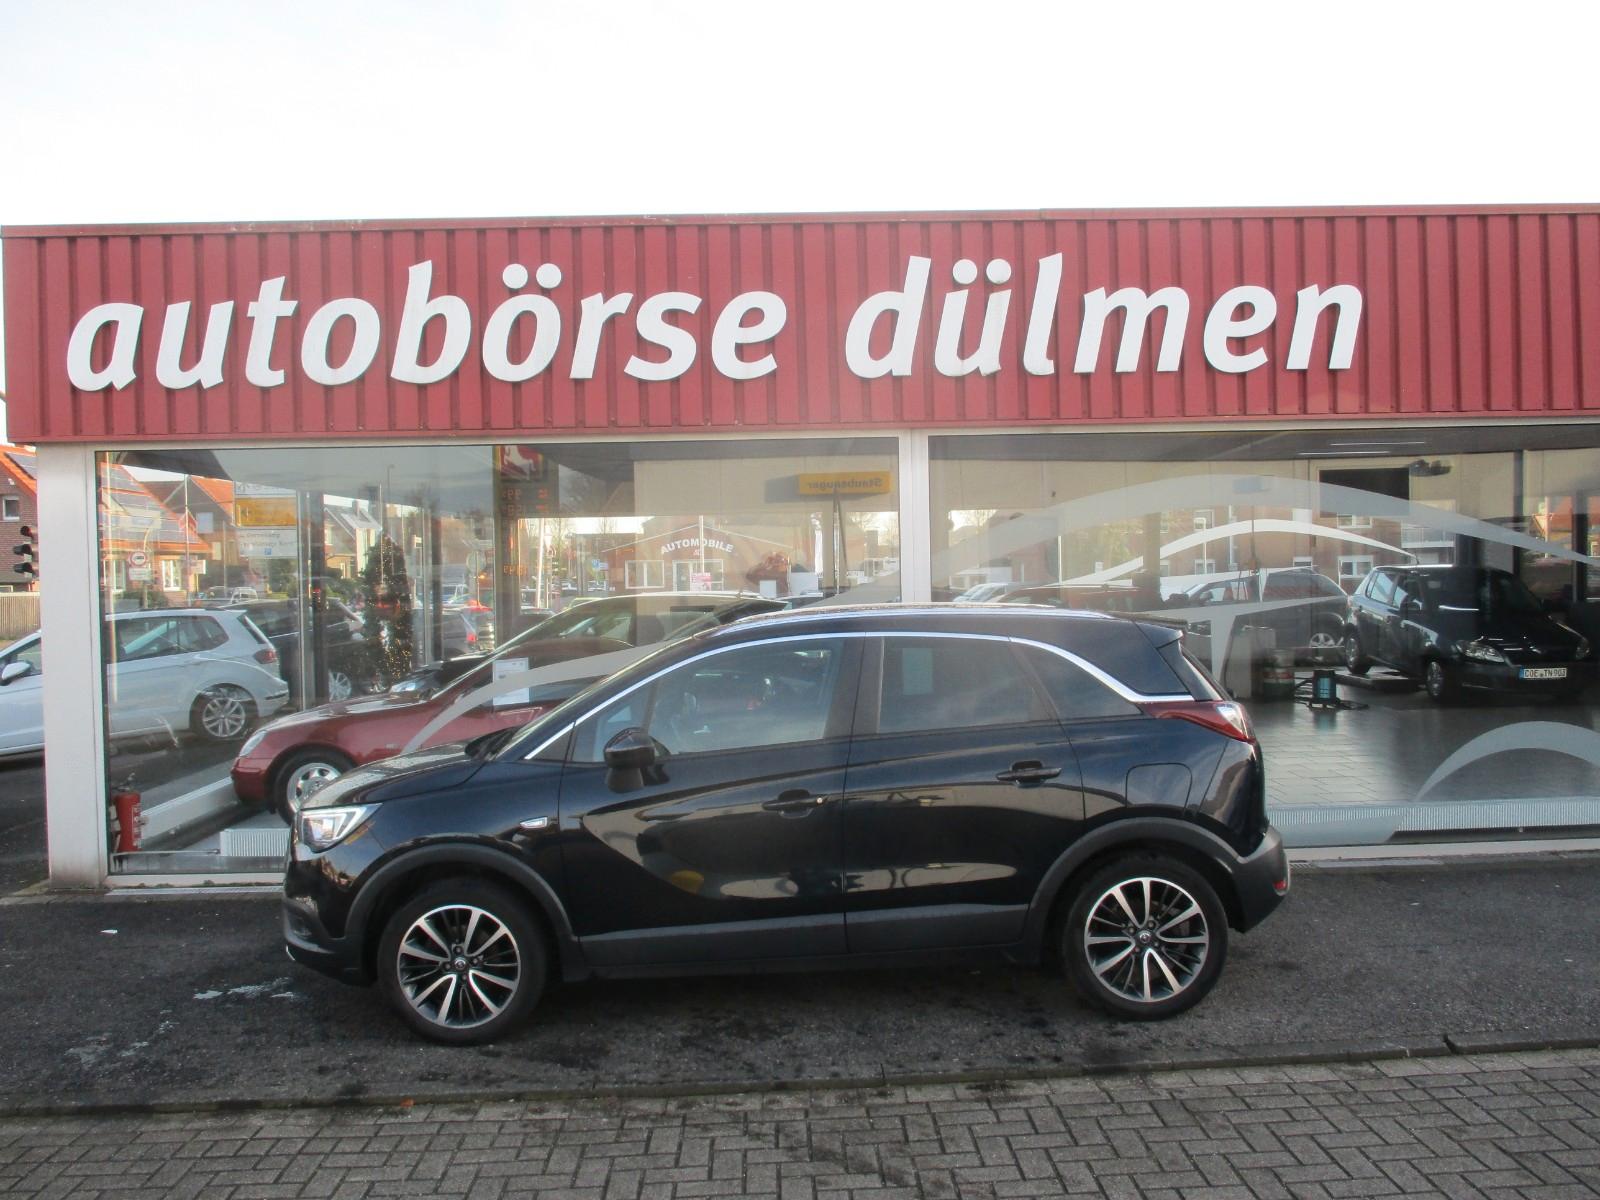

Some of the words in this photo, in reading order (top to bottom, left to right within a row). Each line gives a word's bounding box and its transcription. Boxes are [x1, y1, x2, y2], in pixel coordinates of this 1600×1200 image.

[66, 260, 788, 392] autobörse
[845, 252, 1363, 378] dülmen
[660, 537, 735, 555] AUTOMOBILE
